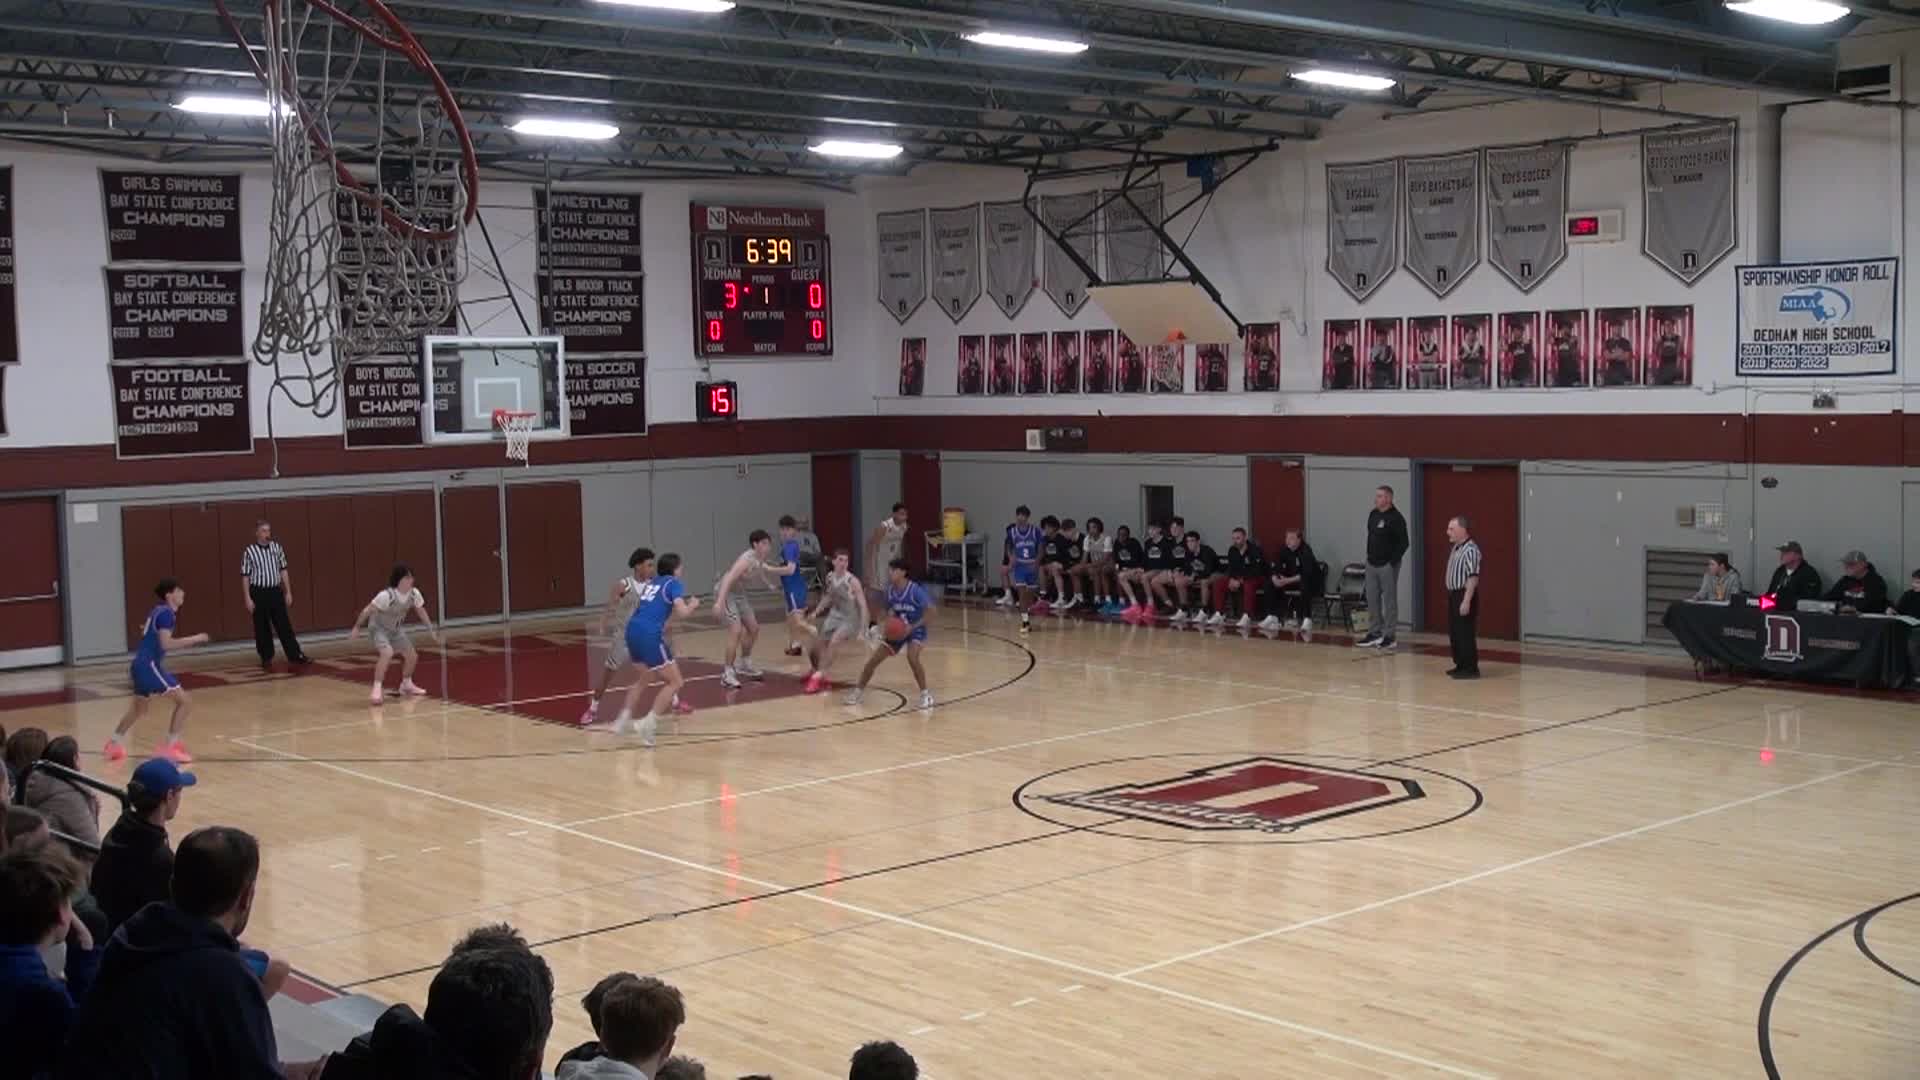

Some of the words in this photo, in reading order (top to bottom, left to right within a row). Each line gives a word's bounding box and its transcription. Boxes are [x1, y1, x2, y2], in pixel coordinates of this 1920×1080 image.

[122, 177, 161, 191] GIRLS
[166, 179, 223, 192] SWIMMING
[110, 194, 130, 208] BAY
[134, 195, 167, 209] STATE
[171, 196, 235, 210] CONFERENCE
[123, 211, 225, 227] CHAMPIONS
[559, 212, 583, 225] STATE
[551, 227, 629, 241] CHAMPIONS
[746, 238, 792, 264] 6:39
[124, 274, 226, 288] SOFTBALL
[752, 275, 775, 284] PERIOD
[791, 268, 821, 281] GUEST
[1744, 269, 1821, 286] SPORTSMANSHIP
[1825, 267, 1858, 283] HONOR
[1863, 264, 1889, 280] ROLL
[608, 280, 633, 292] TRACK
[114, 291, 134, 305] BAY
[137, 291, 169, 305] STATE
[173, 291, 237, 305] CONFERENCE
[561, 295, 587, 307] STATE
[590, 295, 640, 308] CONFERENCE
[724, 282, 737, 309] 3
[764, 286, 769, 305] 1
[808, 283, 823, 309] 0
[1782, 298, 1816, 309] MIAA
[126, 309, 228, 322] CHAMPIONS
[553, 311, 632, 323] CHAMPIONS
[743, 311, 768, 320] PLAYER
[709, 320, 721, 341] 0
[812, 319, 823, 340] 0
[1754, 328, 1797, 342] DEDHAM
[1803, 327, 1828, 340] HIGH
[1833, 325, 1875, 340] SCHOOL
[588, 362, 636, 375] SOCCER
[1770, 358, 1796, 370] 2020
[1800, 358, 1827, 370] 2022
[131, 369, 231, 383] FOOTBALL
[355, 367, 380, 380] BOYS
[384, 367, 415, 379] INDOOR
[349, 384, 366, 398] BAY
[369, 383, 398, 397] STATE
[593, 377, 641, 390] CONFERENCE
[120, 388, 139, 402] BAY
[145, 387, 177, 401] STATE
[181, 385, 243, 399] CONFERENCE
[566, 393, 634, 407] HAMPIONS
[711, 388, 729, 413] 15
[133, 403, 234, 419] CHAMPIONS
[1023, 547, 1029, 558] 2
